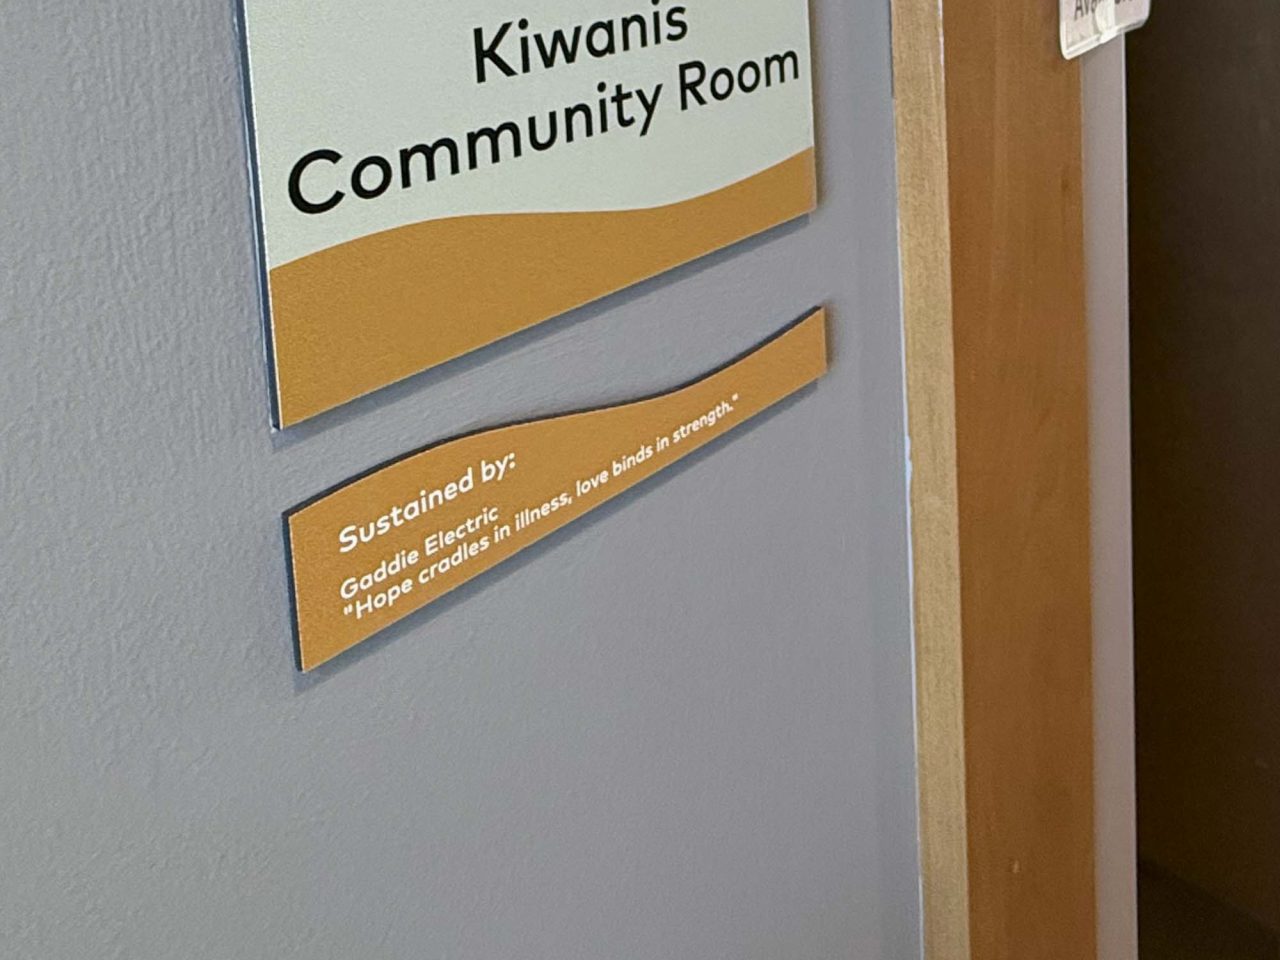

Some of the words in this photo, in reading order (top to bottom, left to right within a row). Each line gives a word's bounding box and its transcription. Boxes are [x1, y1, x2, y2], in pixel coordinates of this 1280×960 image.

[287, 82, 662, 215] Community
[679, 51, 799, 111] Room
[338, 468, 474, 553] Sustained
[480, 453, 517, 483] by:
[340, 535, 419, 599] Gaddie
[424, 506, 499, 556] Electric
[343, 579, 413, 619] "Hope
[418, 537, 490, 583] cradles
[492, 525, 511, 543] in
[515, 493, 573, 532] illness,
[575, 469, 609, 497] love
[612, 444, 654, 476] binds
[656, 437, 673, 456] in
